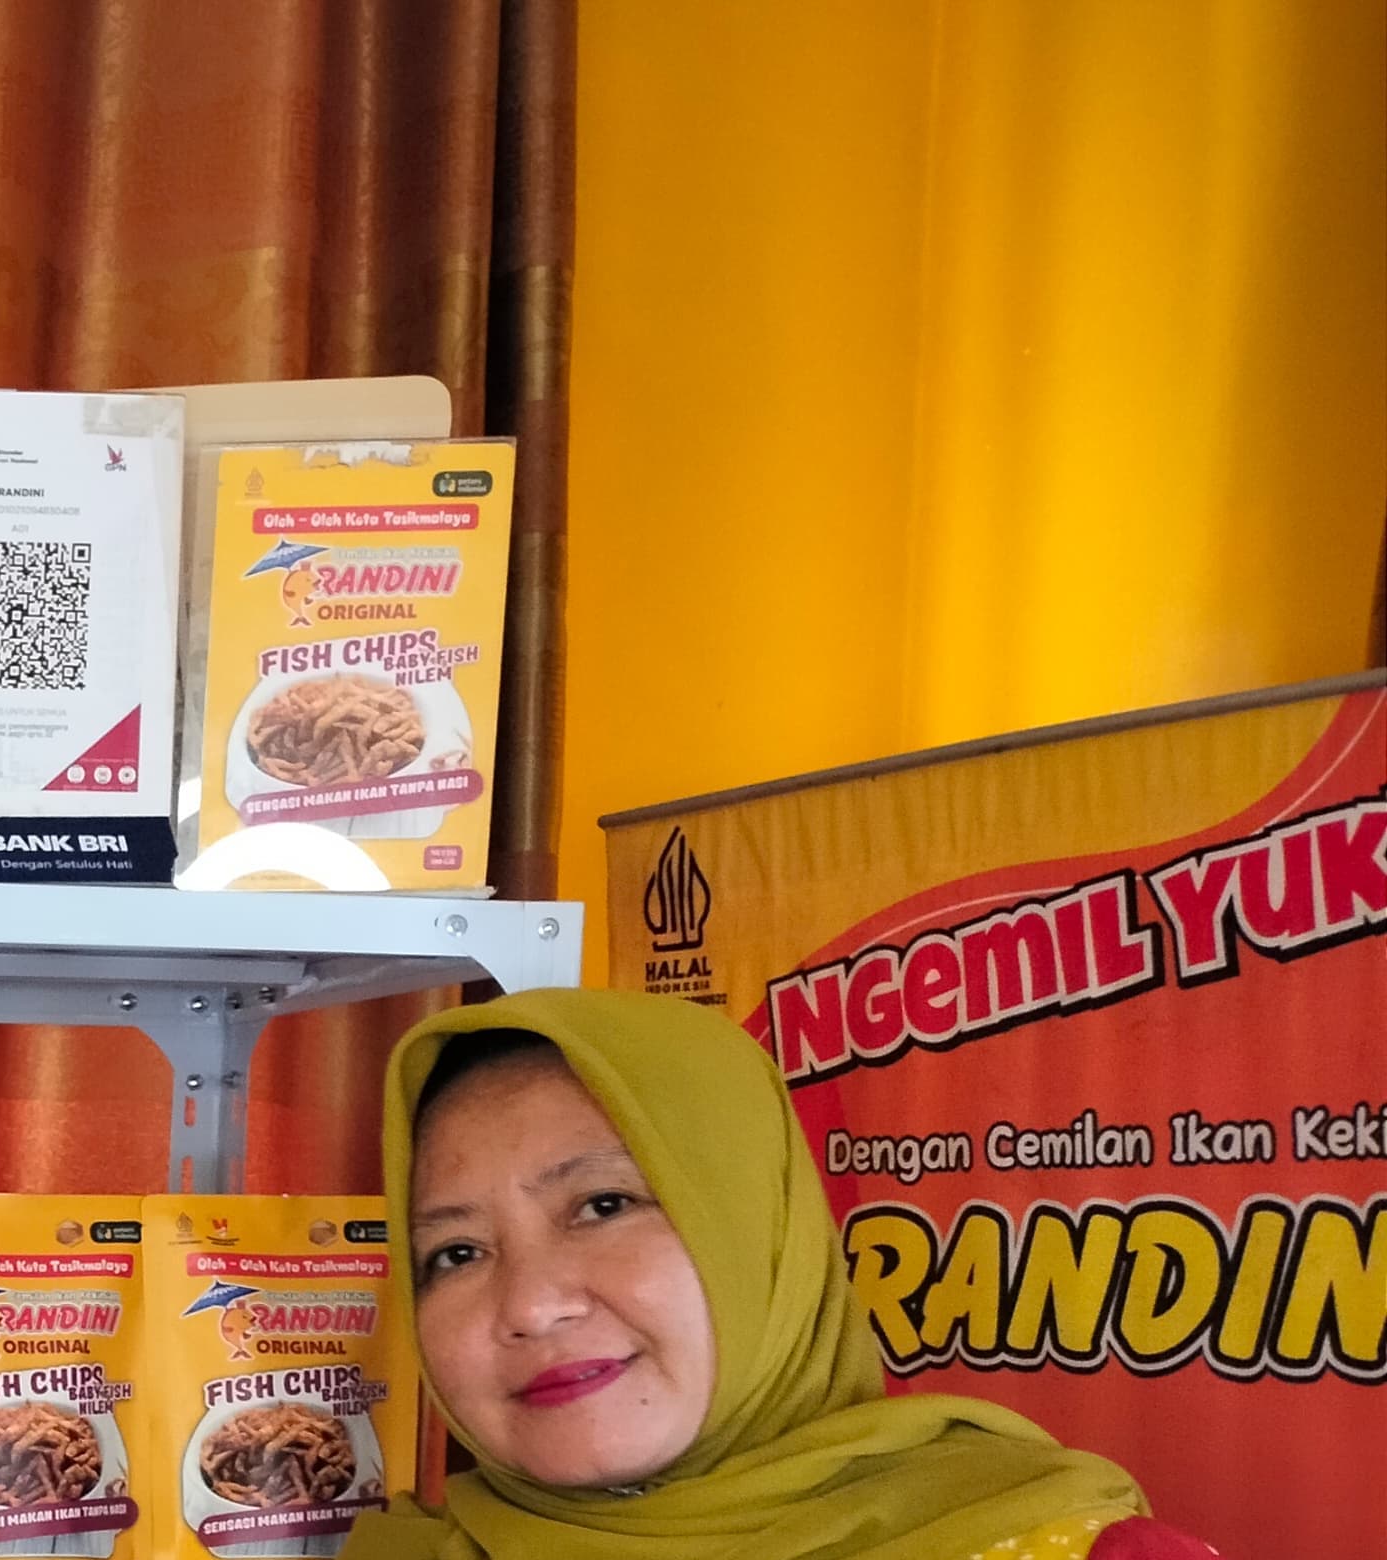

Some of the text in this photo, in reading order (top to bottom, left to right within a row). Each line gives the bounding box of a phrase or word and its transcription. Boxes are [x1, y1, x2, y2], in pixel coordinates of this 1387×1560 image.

[263, 510, 470, 529] Oleh Oleh Kota Tasikmalaya
[317, 563, 461, 596] RANDINI
[317, 604, 416, 621] ORIGINAL
[260, 630, 438, 678] FISH CHIPS
[383, 645, 479, 672] BABY FISH
[395, 667, 452, 687] NILEM
[245, 776, 469, 816] SENSASI MAKAN IKAN TANPA NASI
[78, 836, 128, 852] BRI
[1, 860, 52, 871] Dengan
[56, 861, 102, 869] Setulus
[106, 861, 132, 870] Hati
[1149, 800, 1387, 985] YUK
[646, 956, 712, 981] HALAL
[645, 981, 710, 993] INDONESIA
[827, 1101, 1387, 1185] Dengan Cemilan Ikan Keki
[844, 1194, 1387, 1380] RANDIN
[0, 1303, 121, 1335] RANDINI
[252, 1303, 378, 1336] RANDINI
